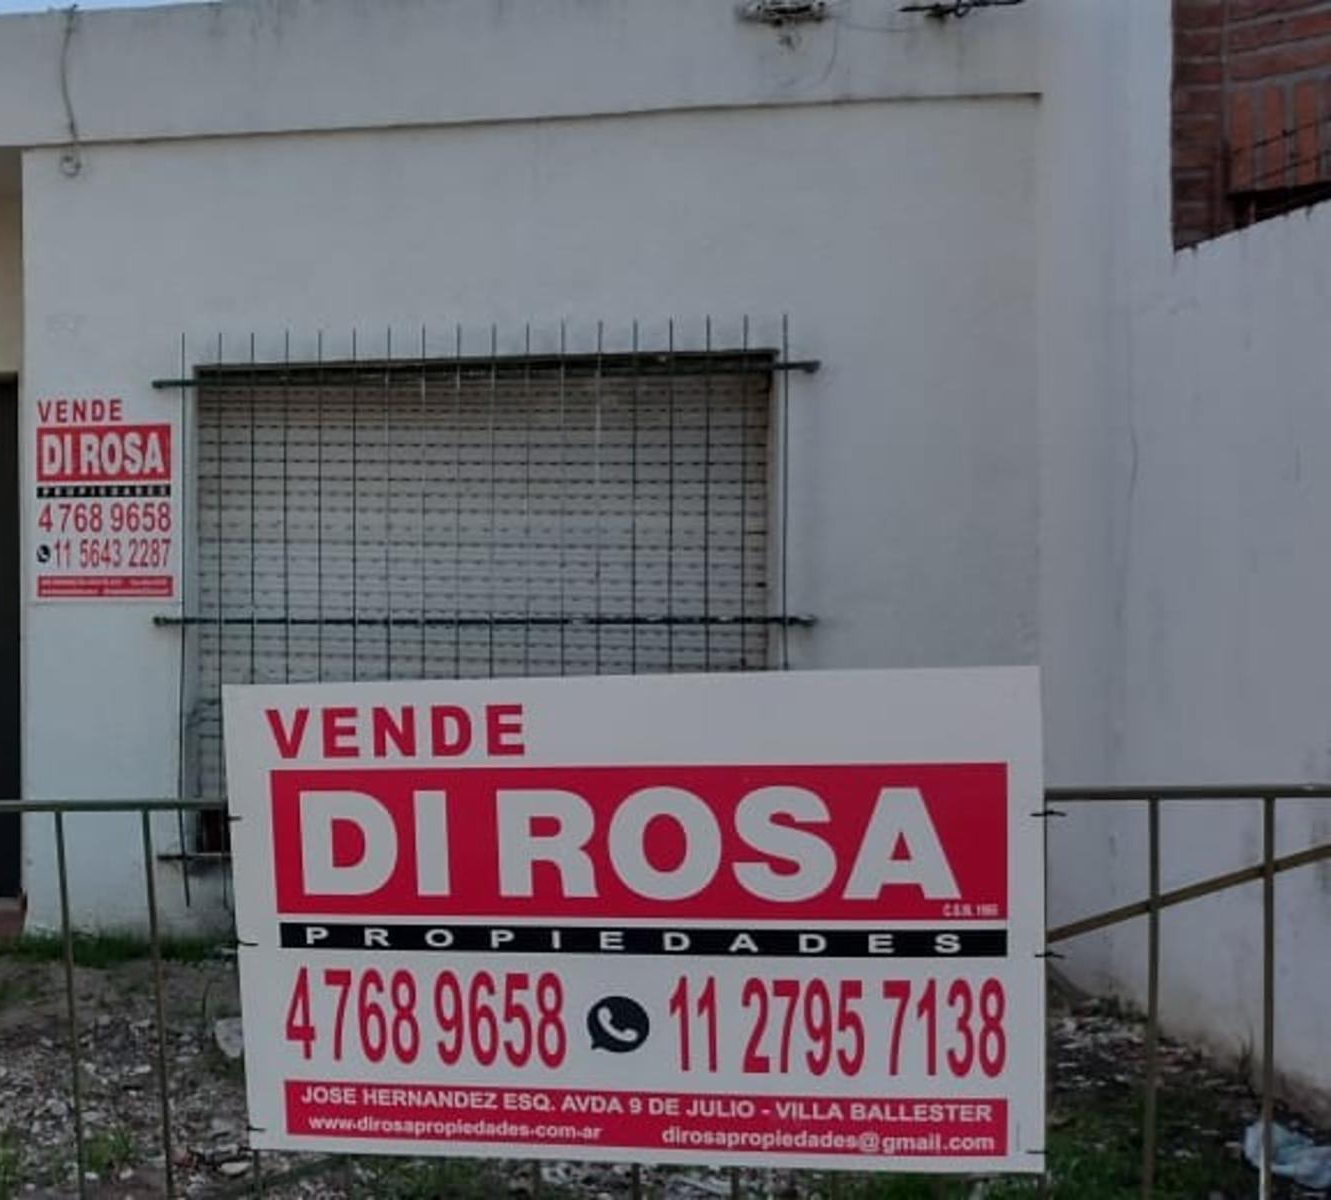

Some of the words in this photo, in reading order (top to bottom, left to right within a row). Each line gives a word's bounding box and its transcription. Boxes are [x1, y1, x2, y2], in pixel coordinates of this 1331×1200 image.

[38, 399, 123, 423] VENDE
[42, 434, 72, 475] DI
[80, 432, 164, 475] ROSA
[110, 502, 171, 532] 9658
[55, 539, 71, 568] 11
[80, 539, 121, 567] 5643
[129, 539, 171, 567] 2287
[266, 704, 525, 759] VENDE
[299, 790, 451, 896] DI
[495, 785, 962, 903] ROSA
[306, 928, 961, 954] PROPIEDADES
[434, 969, 567, 1068] 9658
[669, 975, 719, 1073] 11
[741, 977, 865, 1076] 2795
[882, 977, 1007, 1078] 7138
[301, 1086, 357, 1105] JOSE
[362, 1089, 498, 1110] HERNANDEZ
[503, 1092, 556, 1112] ESQ.
[561, 1095, 625, 1115] AVDA
[630, 1098, 643, 1115] 9
[647, 1098, 680, 1116] DE
[686, 1098, 756, 1118] JULIO
[775, 1101, 844, 1120] VILLA
[849, 1103, 993, 1123] BALLESTER
